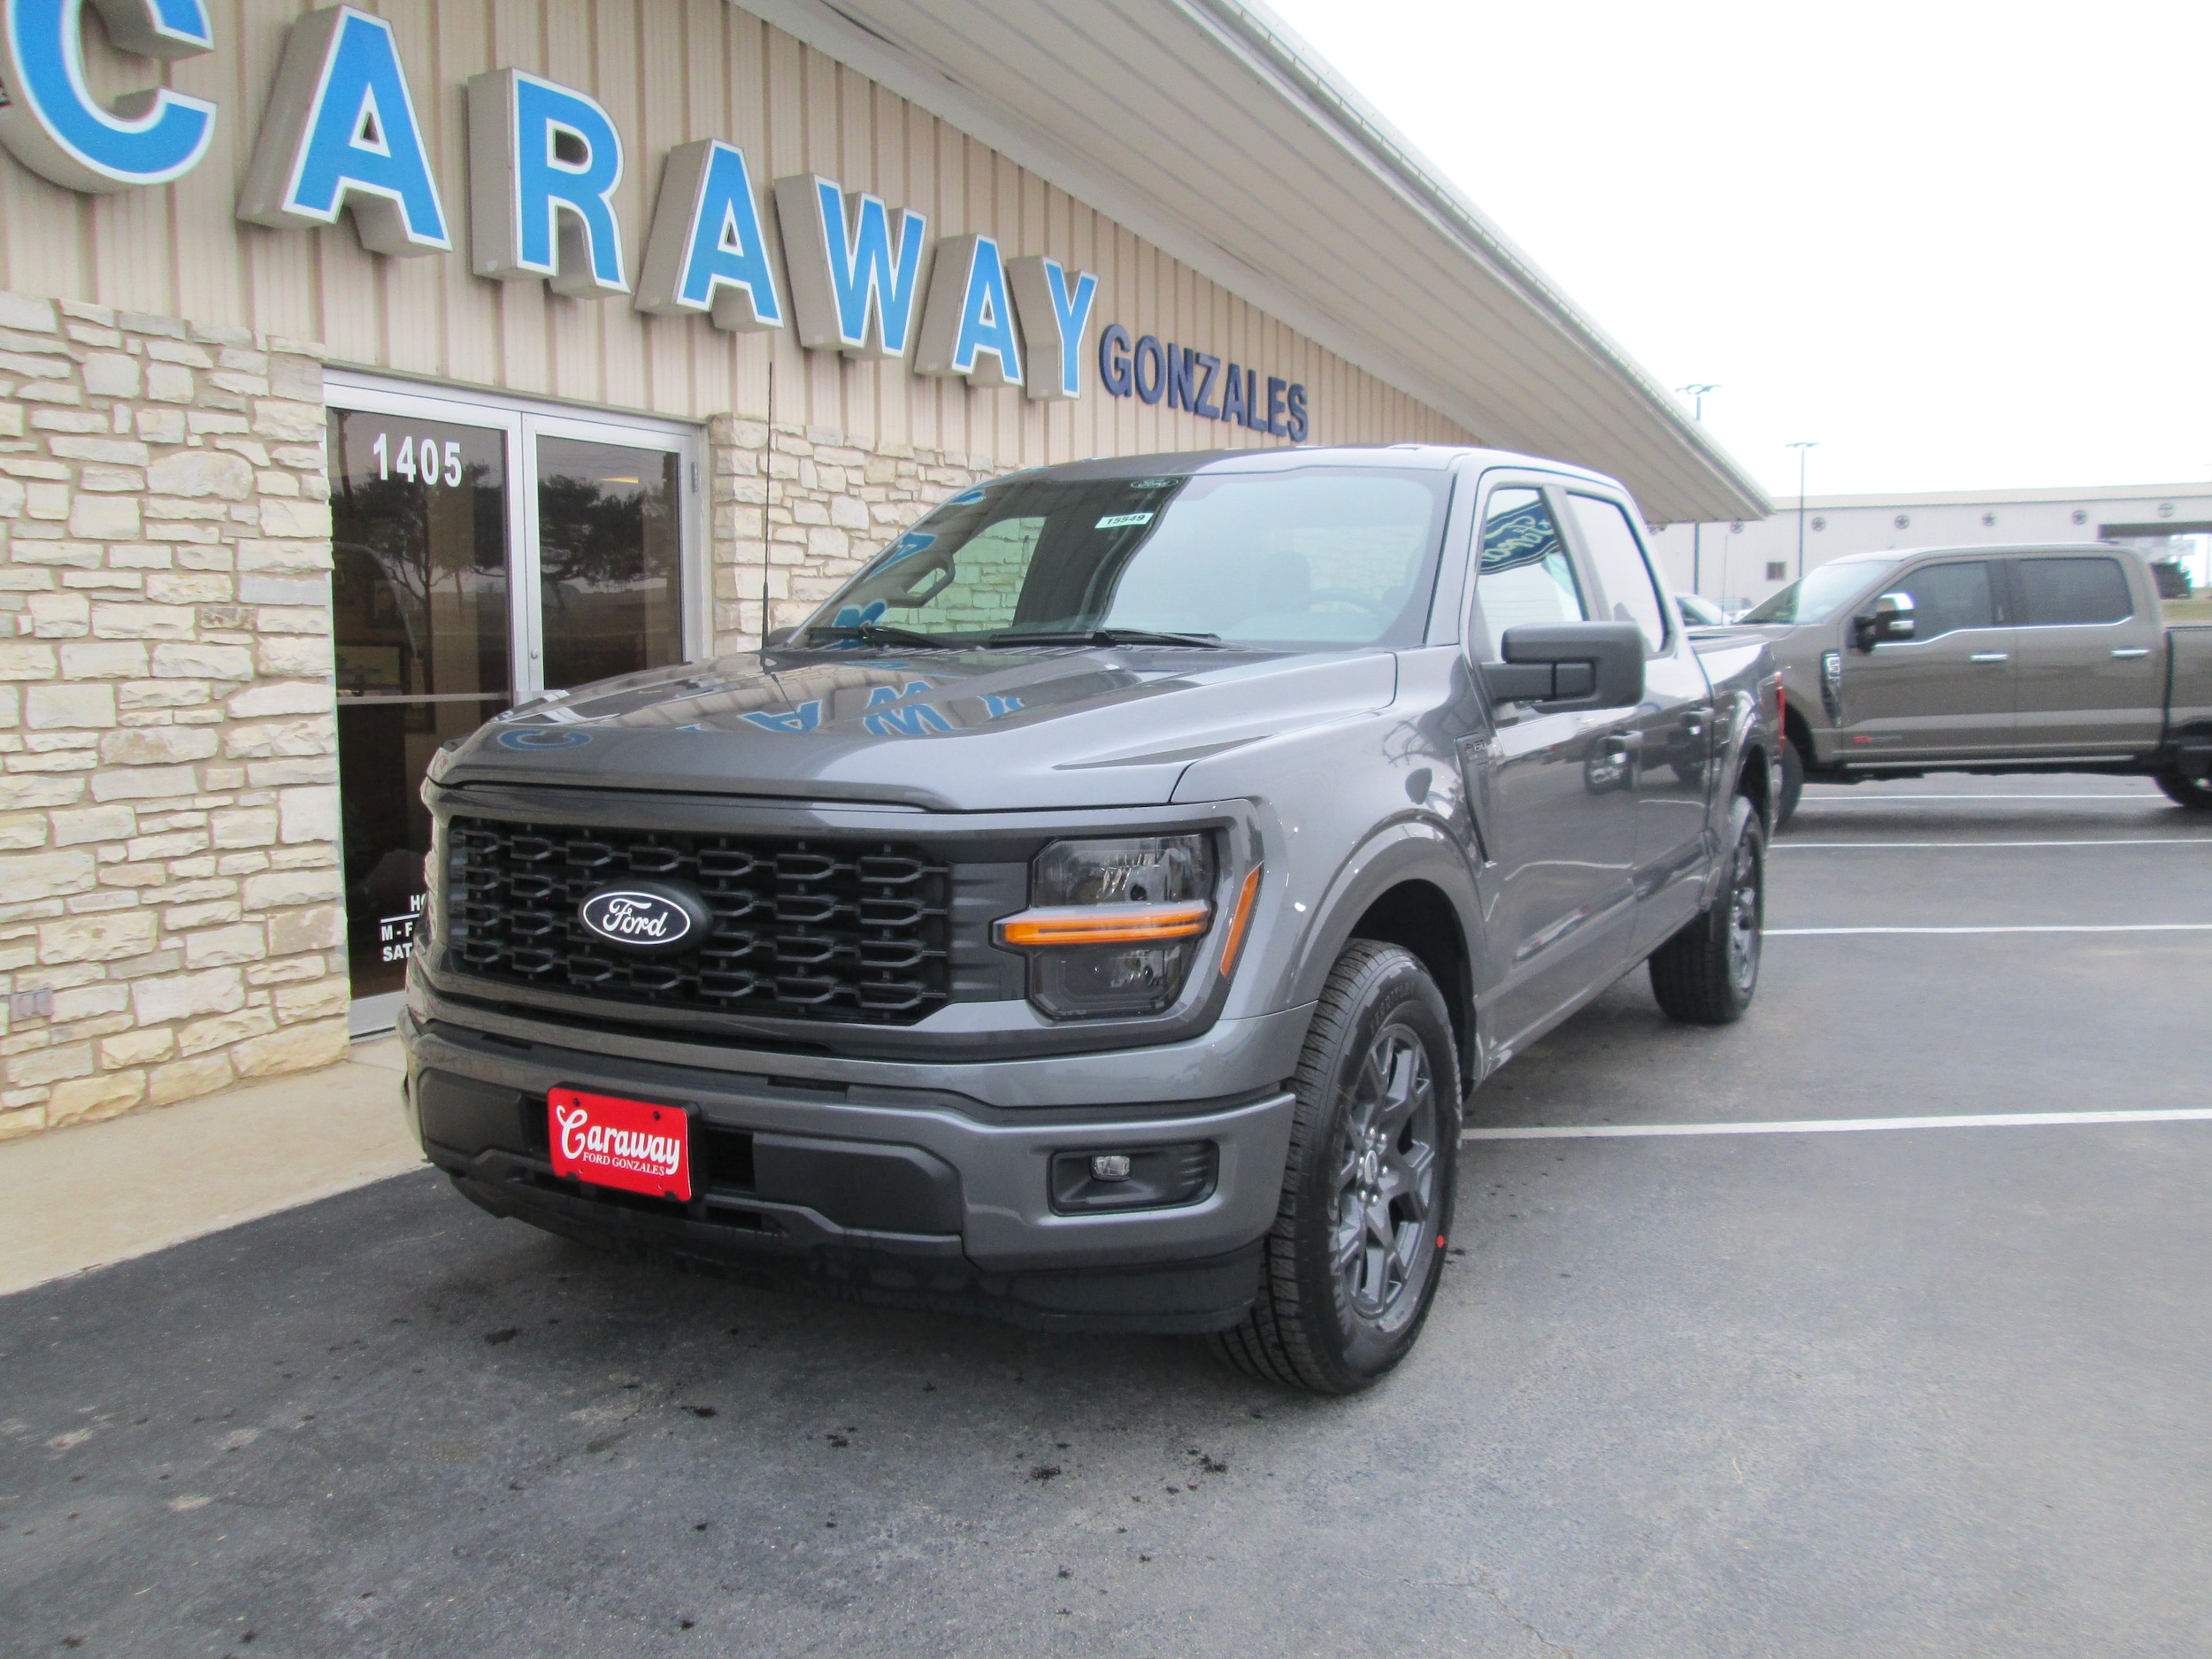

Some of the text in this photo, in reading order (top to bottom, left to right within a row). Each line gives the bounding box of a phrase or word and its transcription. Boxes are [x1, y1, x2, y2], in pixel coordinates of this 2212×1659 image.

[6, 0, 1099, 401] CARAWAY
[1099, 324, 1309, 442] GONZALES
[373, 433, 462, 488] 1405
[1106, 514, 1147, 525] 15549
[602, 898, 669, 937] Ford
[382, 941, 413, 962] SAT
[556, 1105, 680, 1175] Caraway
[582, 1151, 666, 1176] FORD GONZALES
